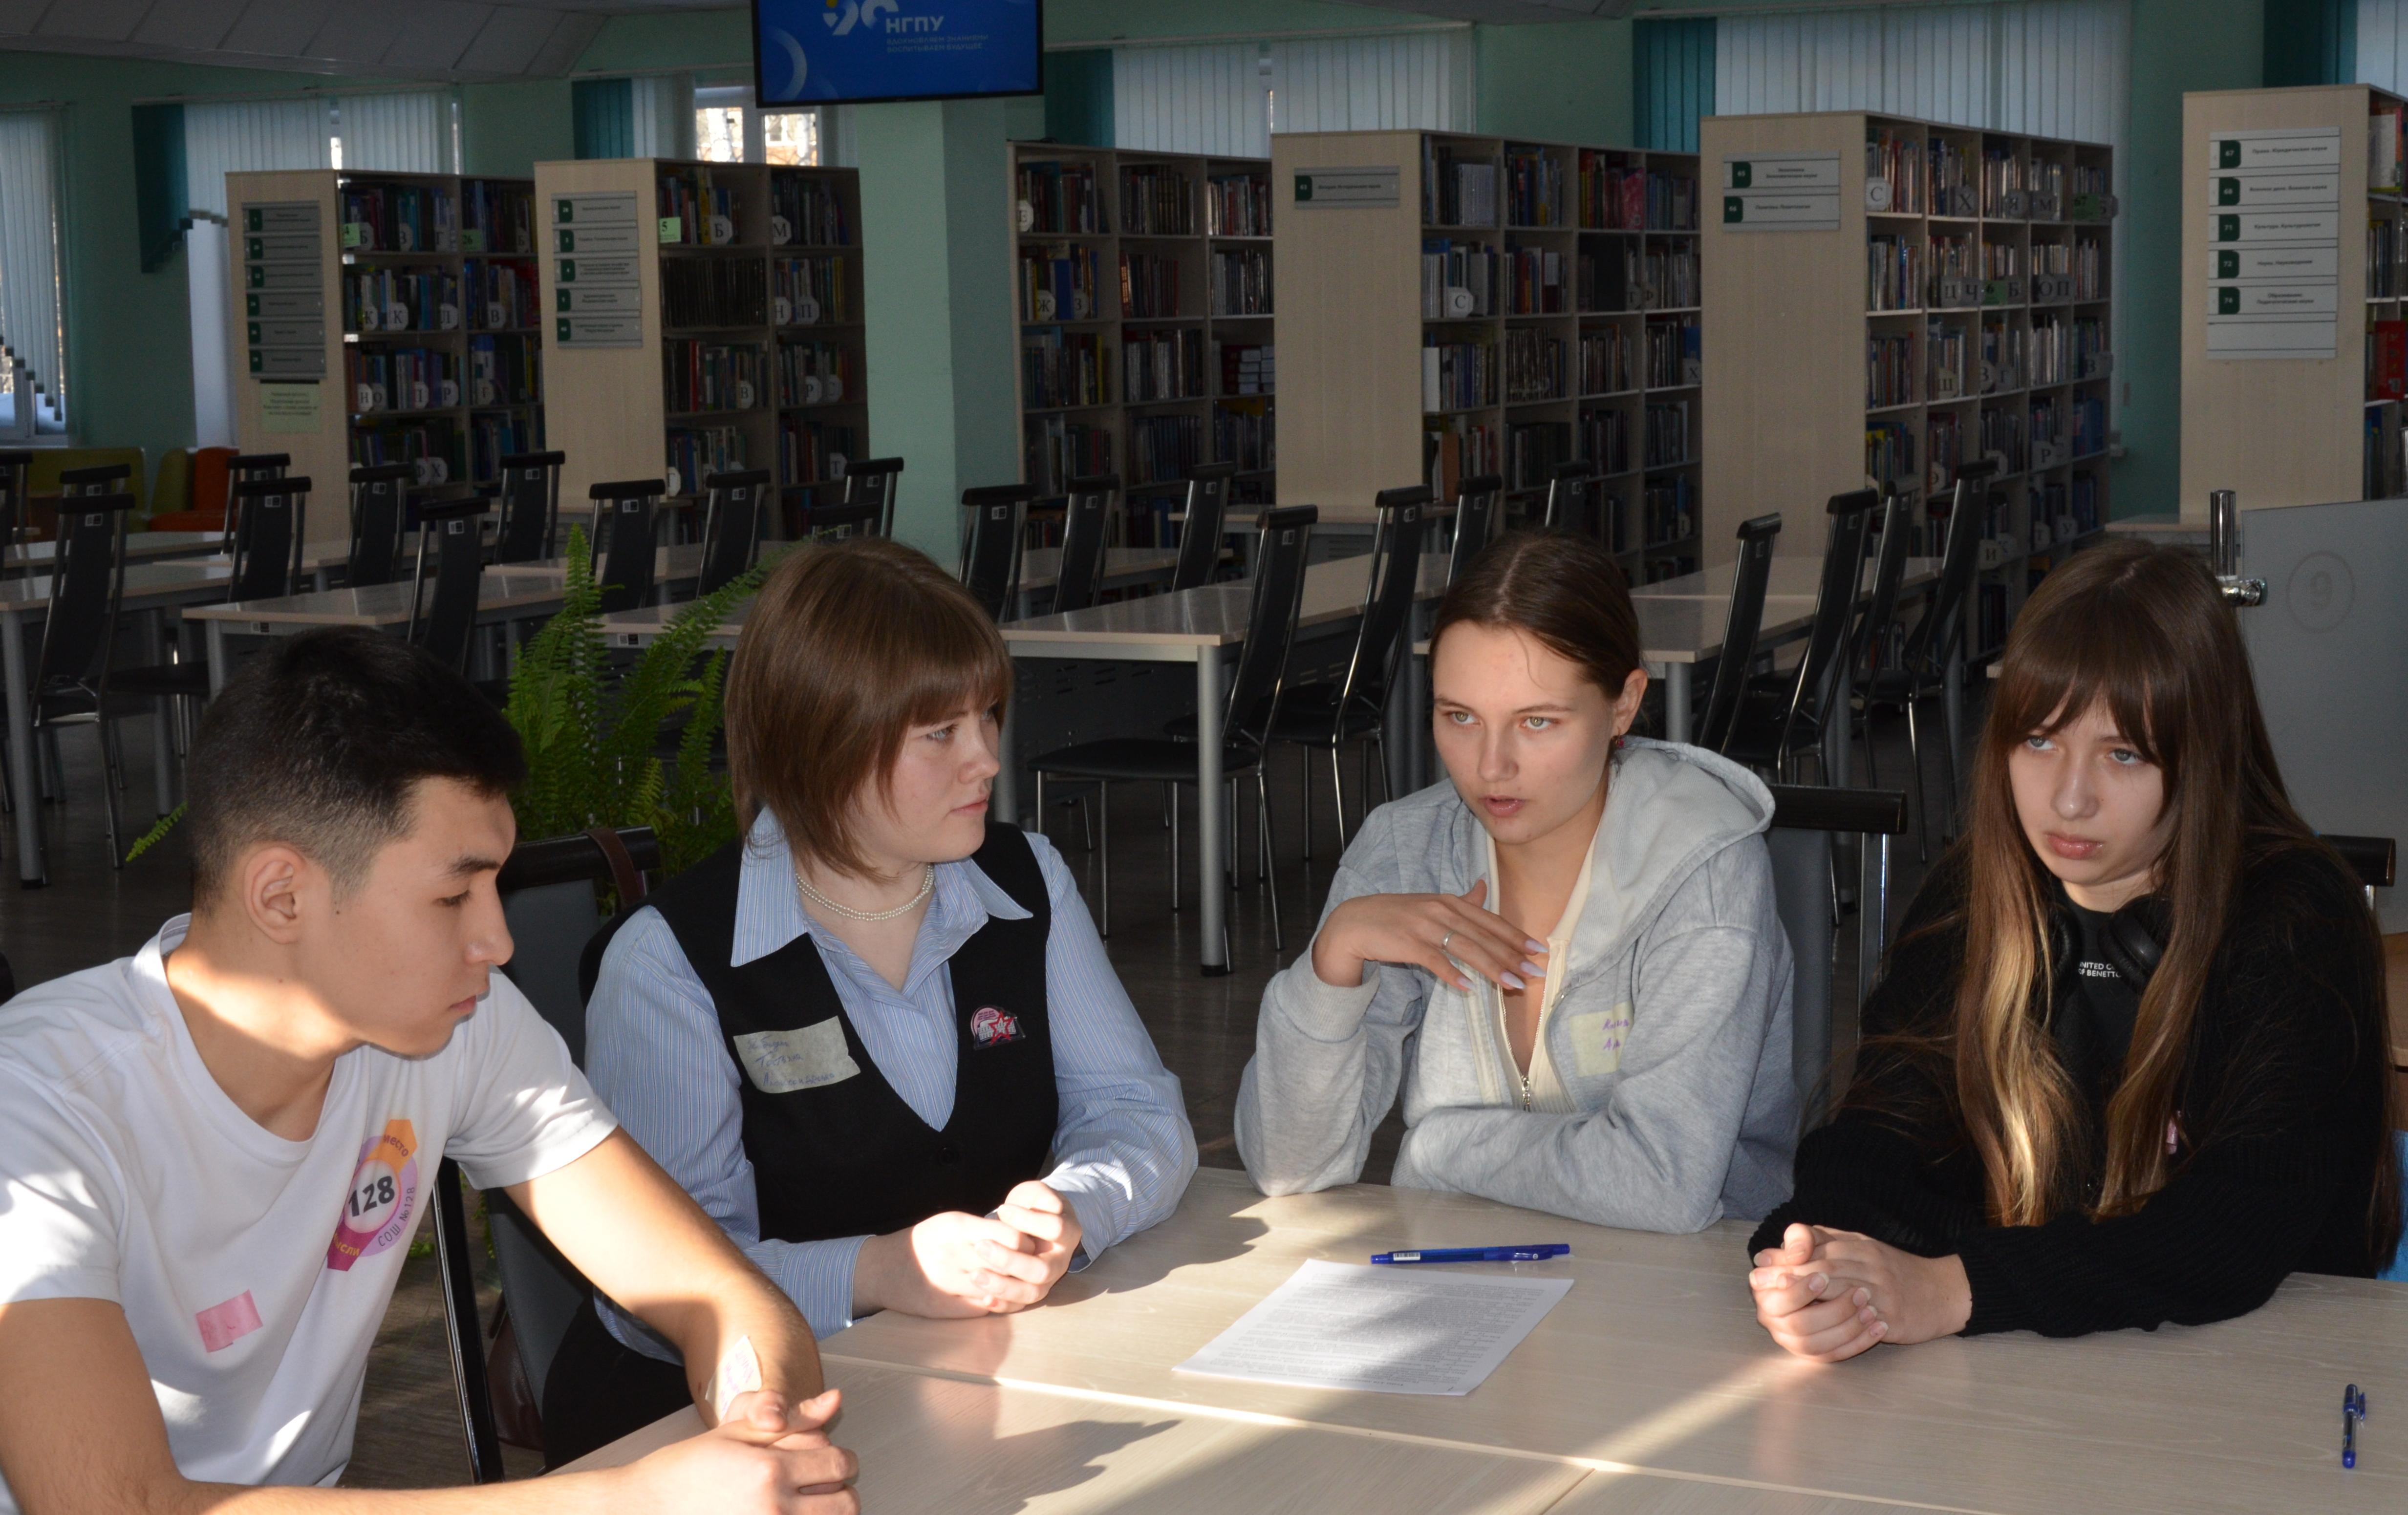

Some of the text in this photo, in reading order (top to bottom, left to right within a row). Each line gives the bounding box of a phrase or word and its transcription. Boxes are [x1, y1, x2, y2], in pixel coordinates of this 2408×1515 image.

[886, 16, 944, 33] НГПУ
[715, 224, 724, 237] Б
[394, 310, 403, 323] К
[348, 1175, 395, 1217] 128
[378, 1224, 401, 1246] СОШ
